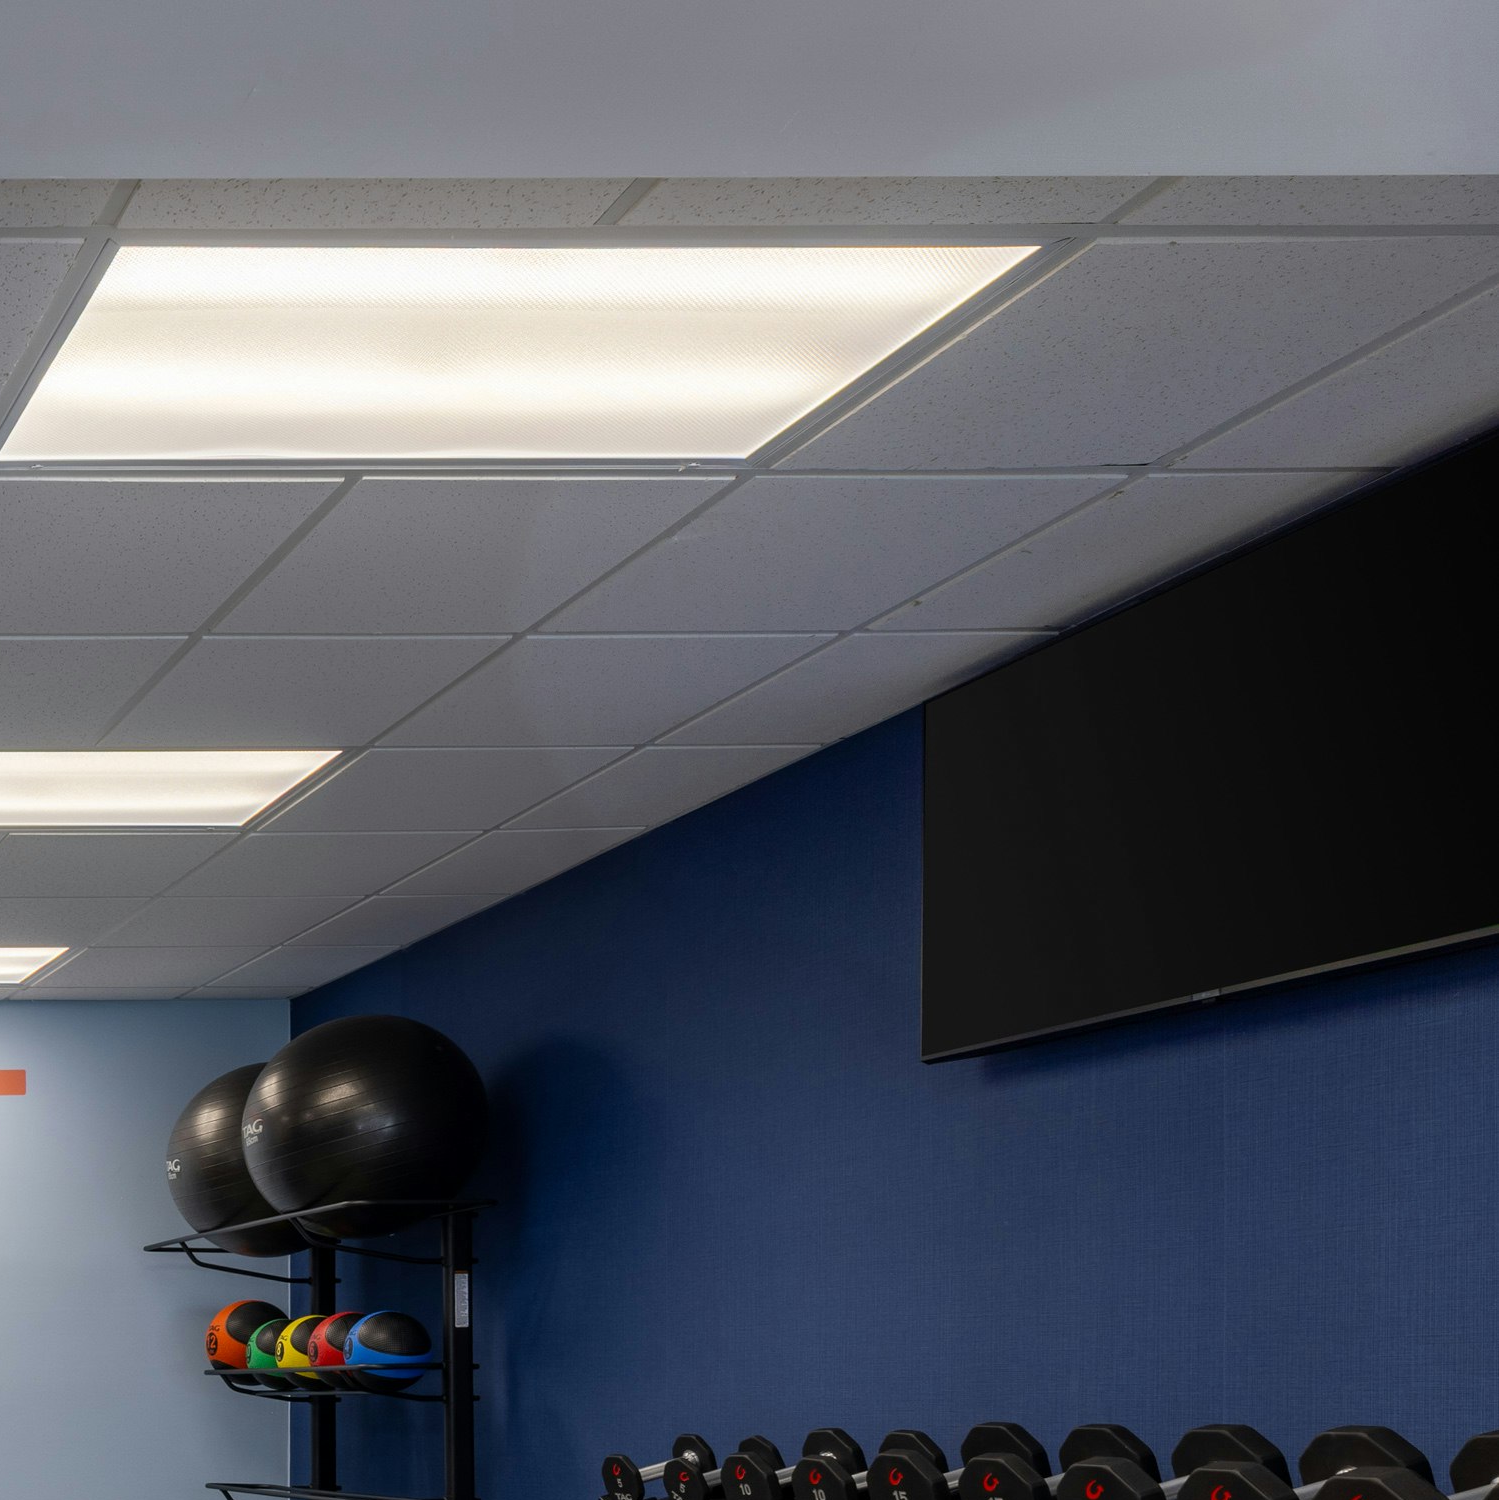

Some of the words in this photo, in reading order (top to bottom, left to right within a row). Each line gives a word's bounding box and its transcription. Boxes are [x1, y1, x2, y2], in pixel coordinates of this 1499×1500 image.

[242, 1119, 263, 1139] TAG
[206, 1334, 216, 1348] 12
[277, 1342, 282, 1355] 8
[617, 1479, 622, 1487] 5
[680, 1483, 685, 1493] 5
[740, 1484, 751, 1495] 10
[813, 1489, 825, 1500] 10
[615, 1493, 632, 1500] TAG
